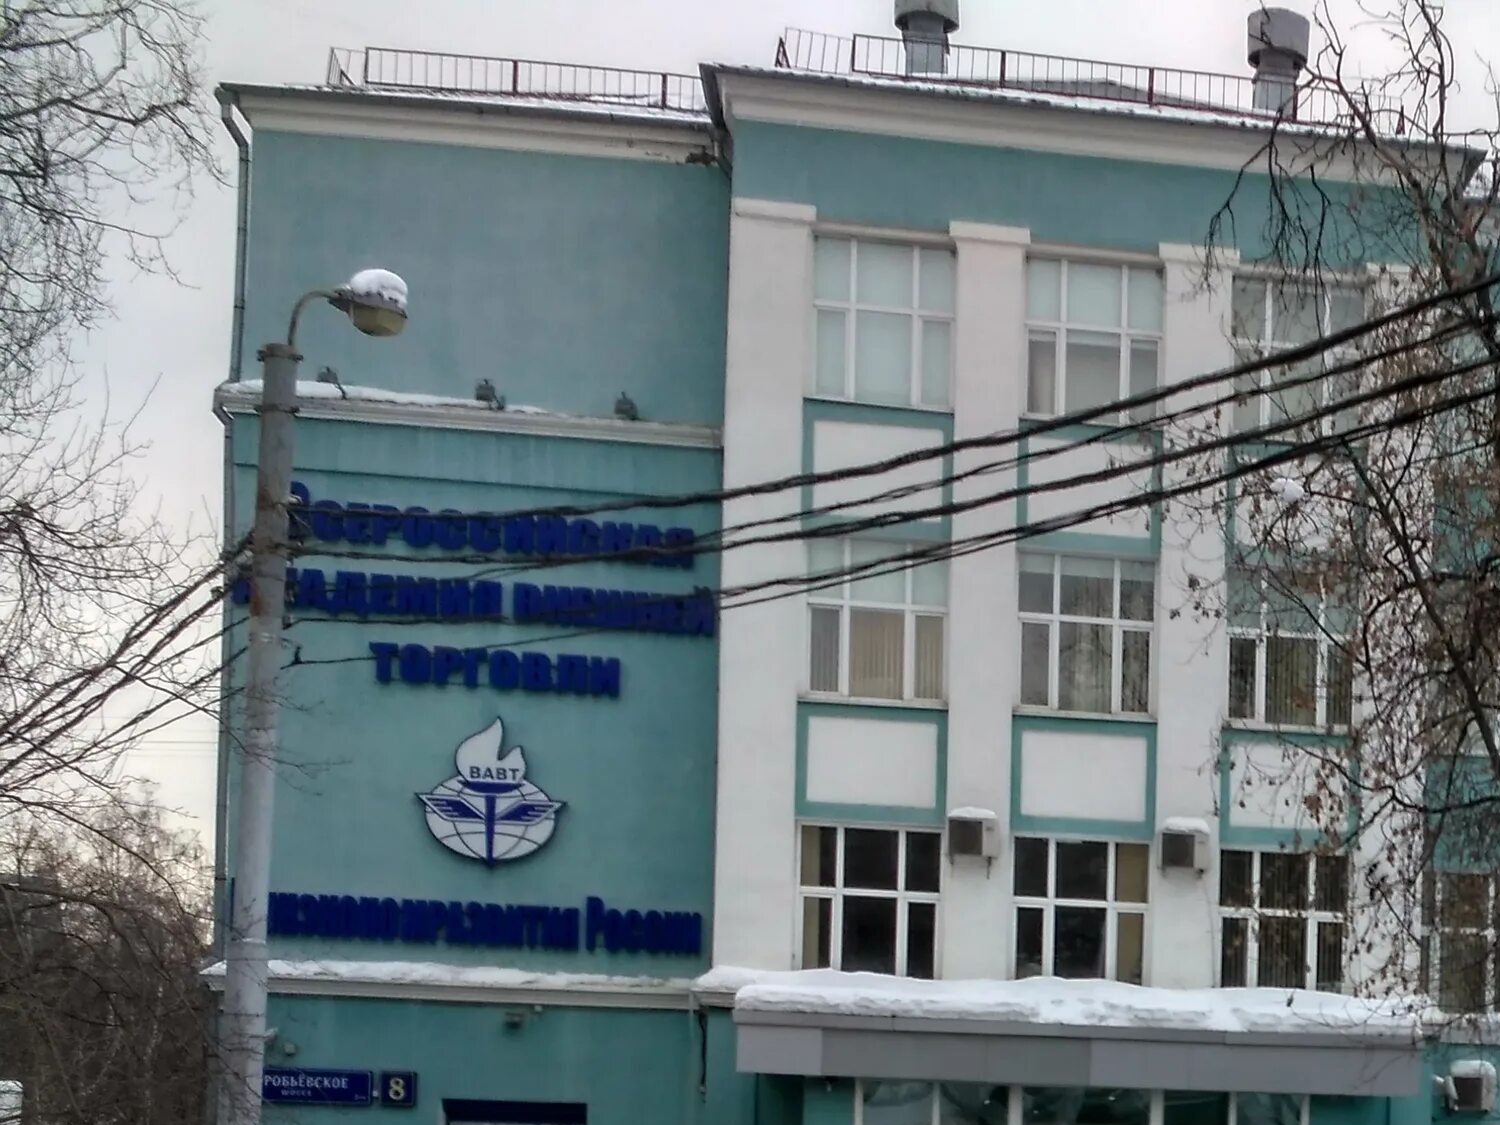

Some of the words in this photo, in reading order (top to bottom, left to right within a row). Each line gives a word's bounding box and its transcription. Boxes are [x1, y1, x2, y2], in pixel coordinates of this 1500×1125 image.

[369, 641, 621, 698] ТОРГОВЛИ
[469, 765, 520, 781] ВАВТ
[389, 1077, 405, 1100] 8
